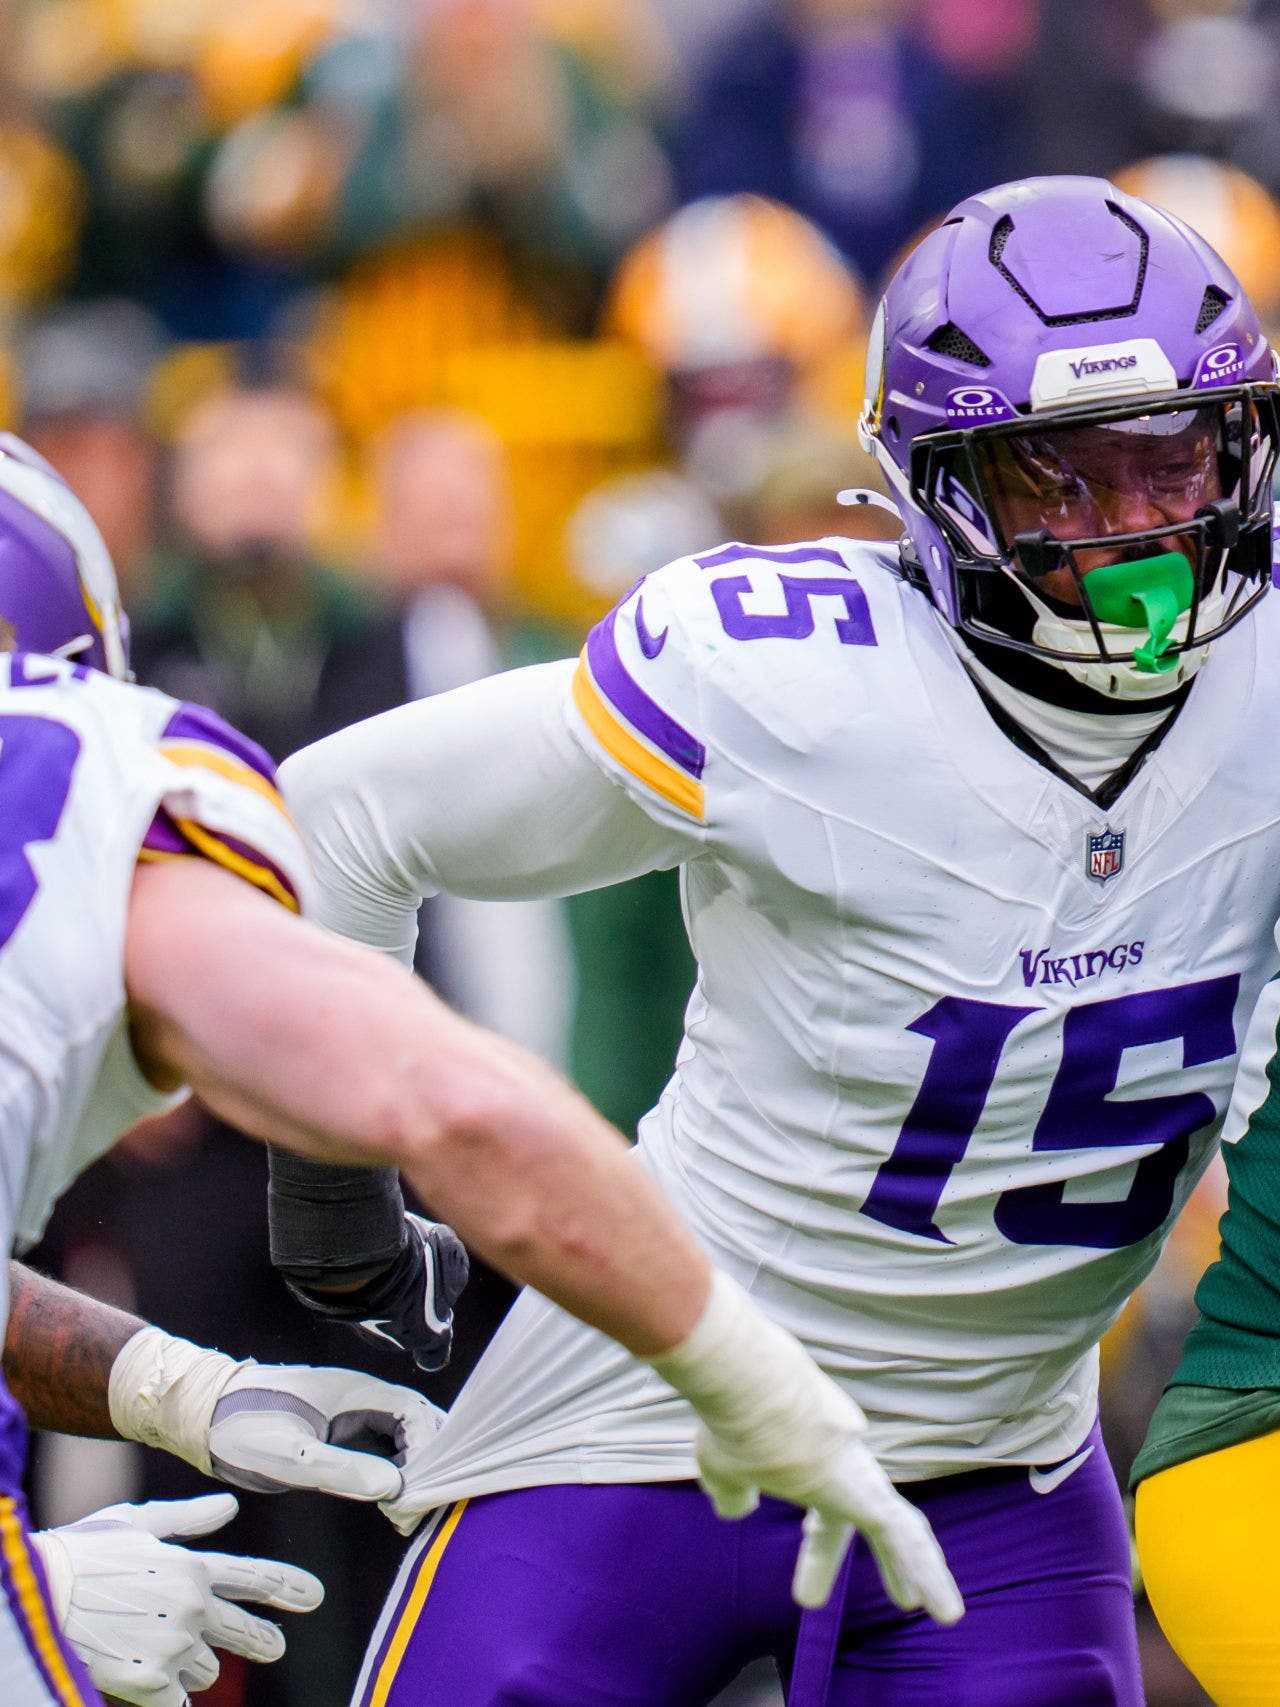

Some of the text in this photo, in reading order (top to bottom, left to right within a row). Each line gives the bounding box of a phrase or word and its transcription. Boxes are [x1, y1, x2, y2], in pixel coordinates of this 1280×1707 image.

[1069, 355, 1137, 379] VIKINGS
[1201, 360, 1244, 383] OAKLEY
[947, 406, 1008, 417] OAKLEY
[693, 545, 878, 647] 15
[1093, 851, 1120, 875] NFL
[1019, 940, 1146, 988] VIKINGS
[859, 972, 1242, 1249] 15
